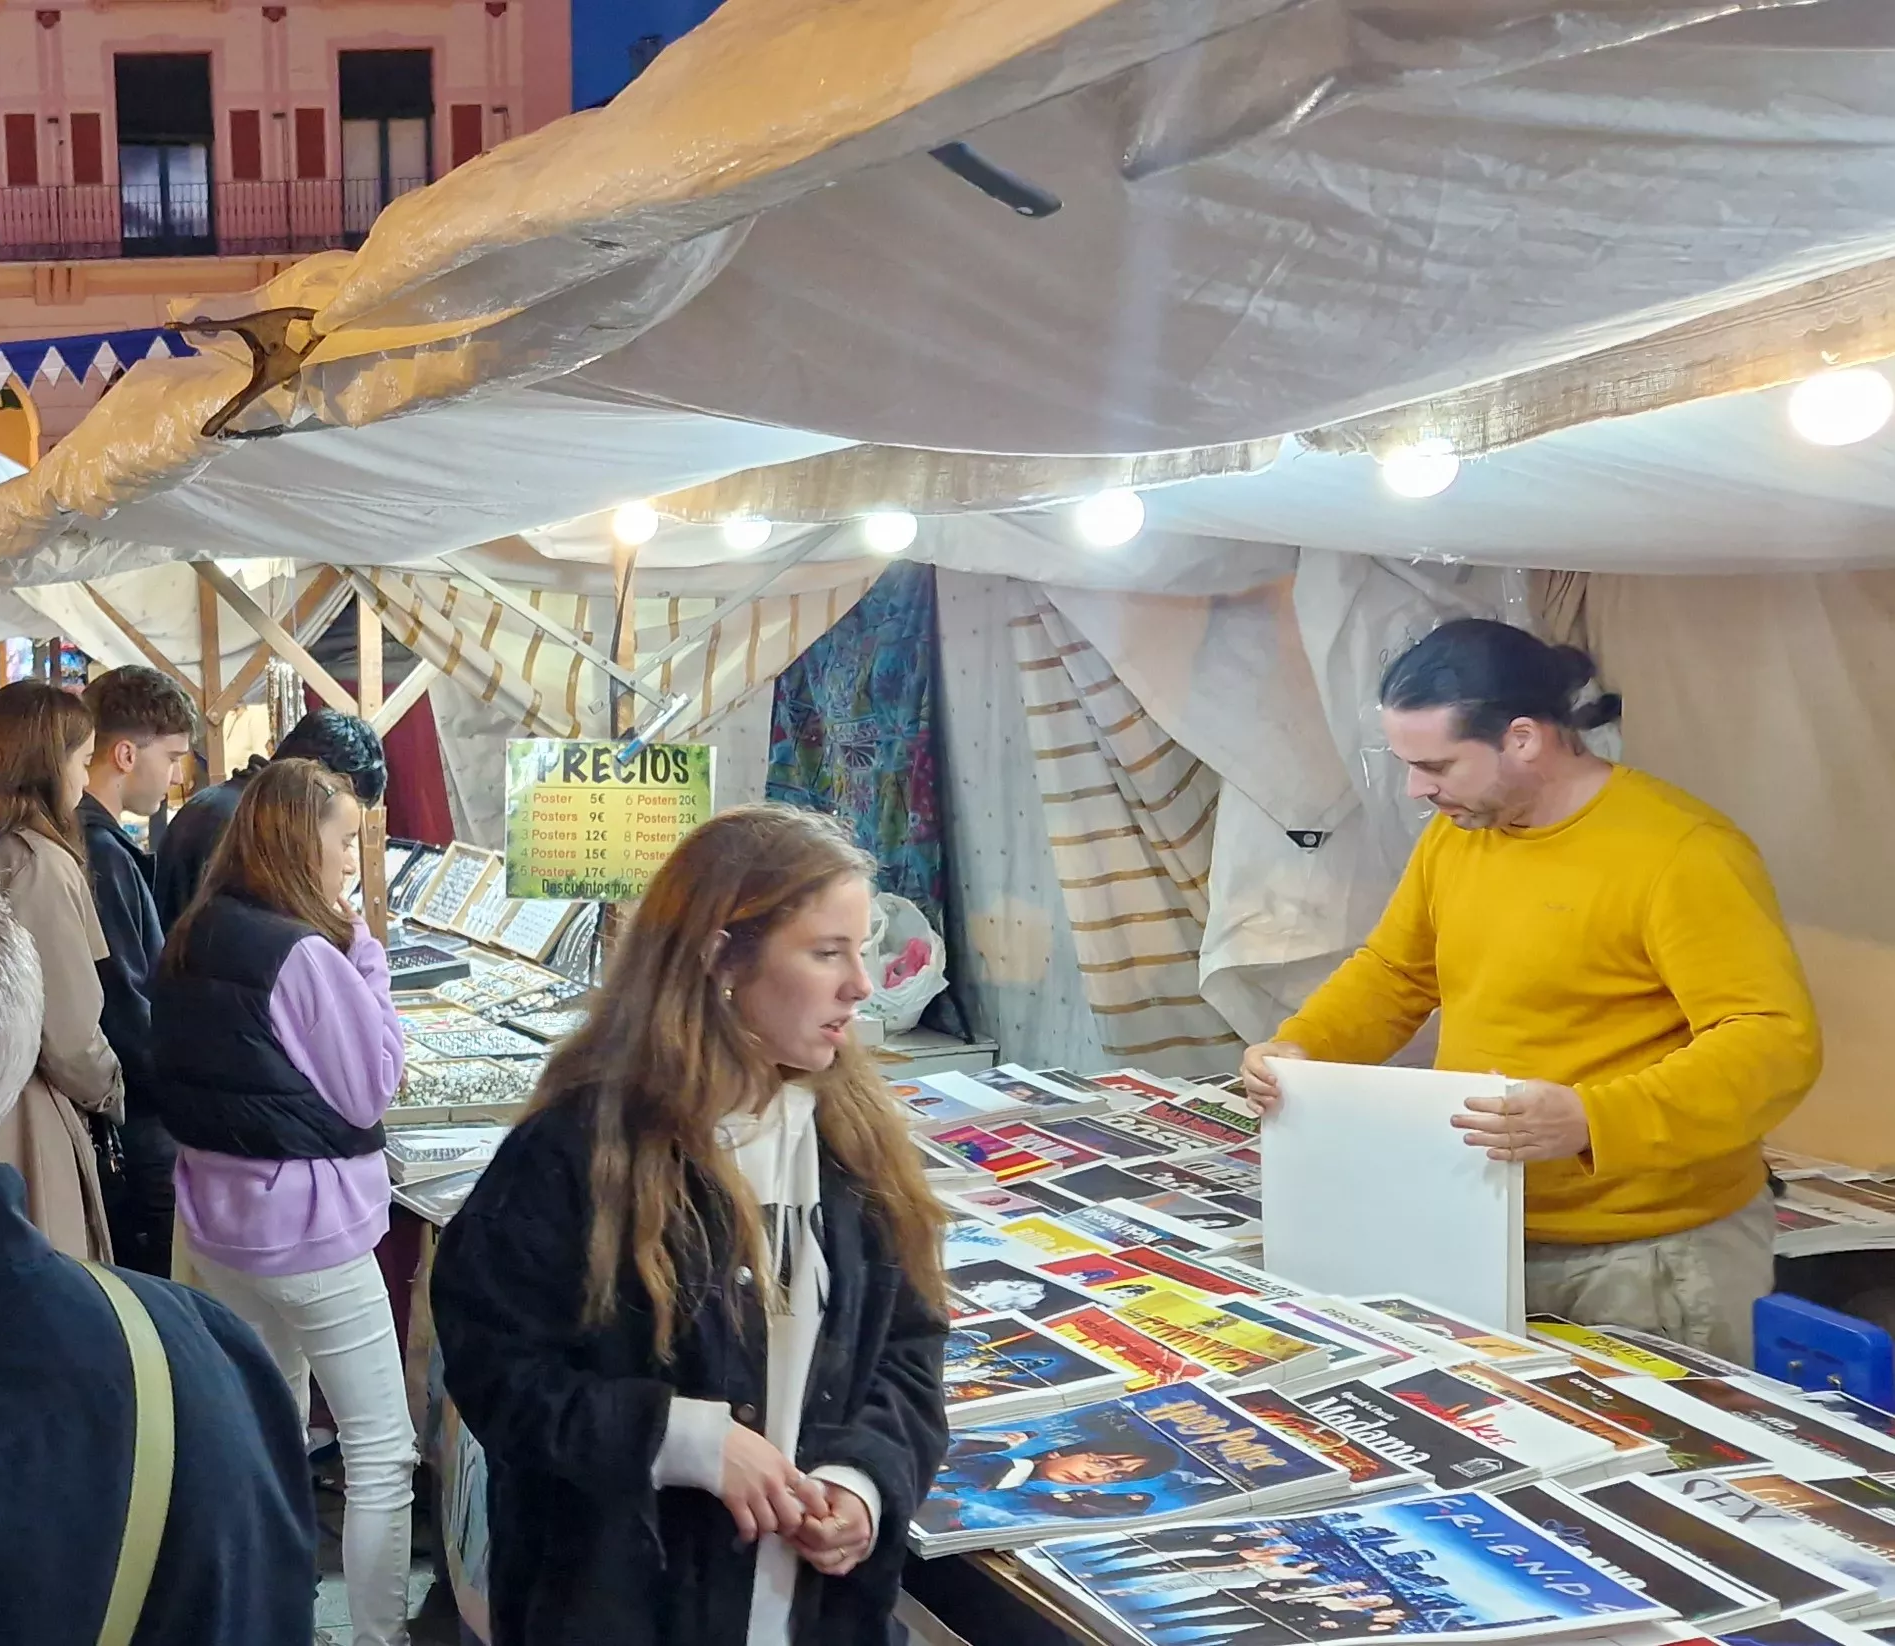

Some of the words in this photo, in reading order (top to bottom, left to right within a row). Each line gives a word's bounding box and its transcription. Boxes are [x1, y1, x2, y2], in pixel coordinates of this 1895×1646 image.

[536, 745, 689, 784] PRECIOS
[533, 793, 572, 804] Poster
[590, 793, 605, 804] 5€
[626, 794, 633, 805] 6
[637, 794, 677, 805] Posters
[679, 794, 697, 805] 20€
[532, 810, 578, 821] Posters
[589, 811, 604, 822] 9€
[625, 812, 632, 823] 7
[637, 812, 677, 824] Posters
[679, 813, 697, 824] 23€
[532, 829, 577, 840] Posters
[586, 830, 607, 841] 12€
[624, 831, 631, 842] 8
[636, 831, 676, 842] Posters
[531, 847, 576, 859] Posters
[585, 848, 607, 859] 15€
[624, 850, 631, 860] 9
[531, 866, 576, 877] Posters
[585, 867, 606, 878] 17€
[542, 879, 610, 894] Descuentos
[1320, 1308, 1378, 1331] PRISON
[1305, 1396, 1431, 1466] Madama
